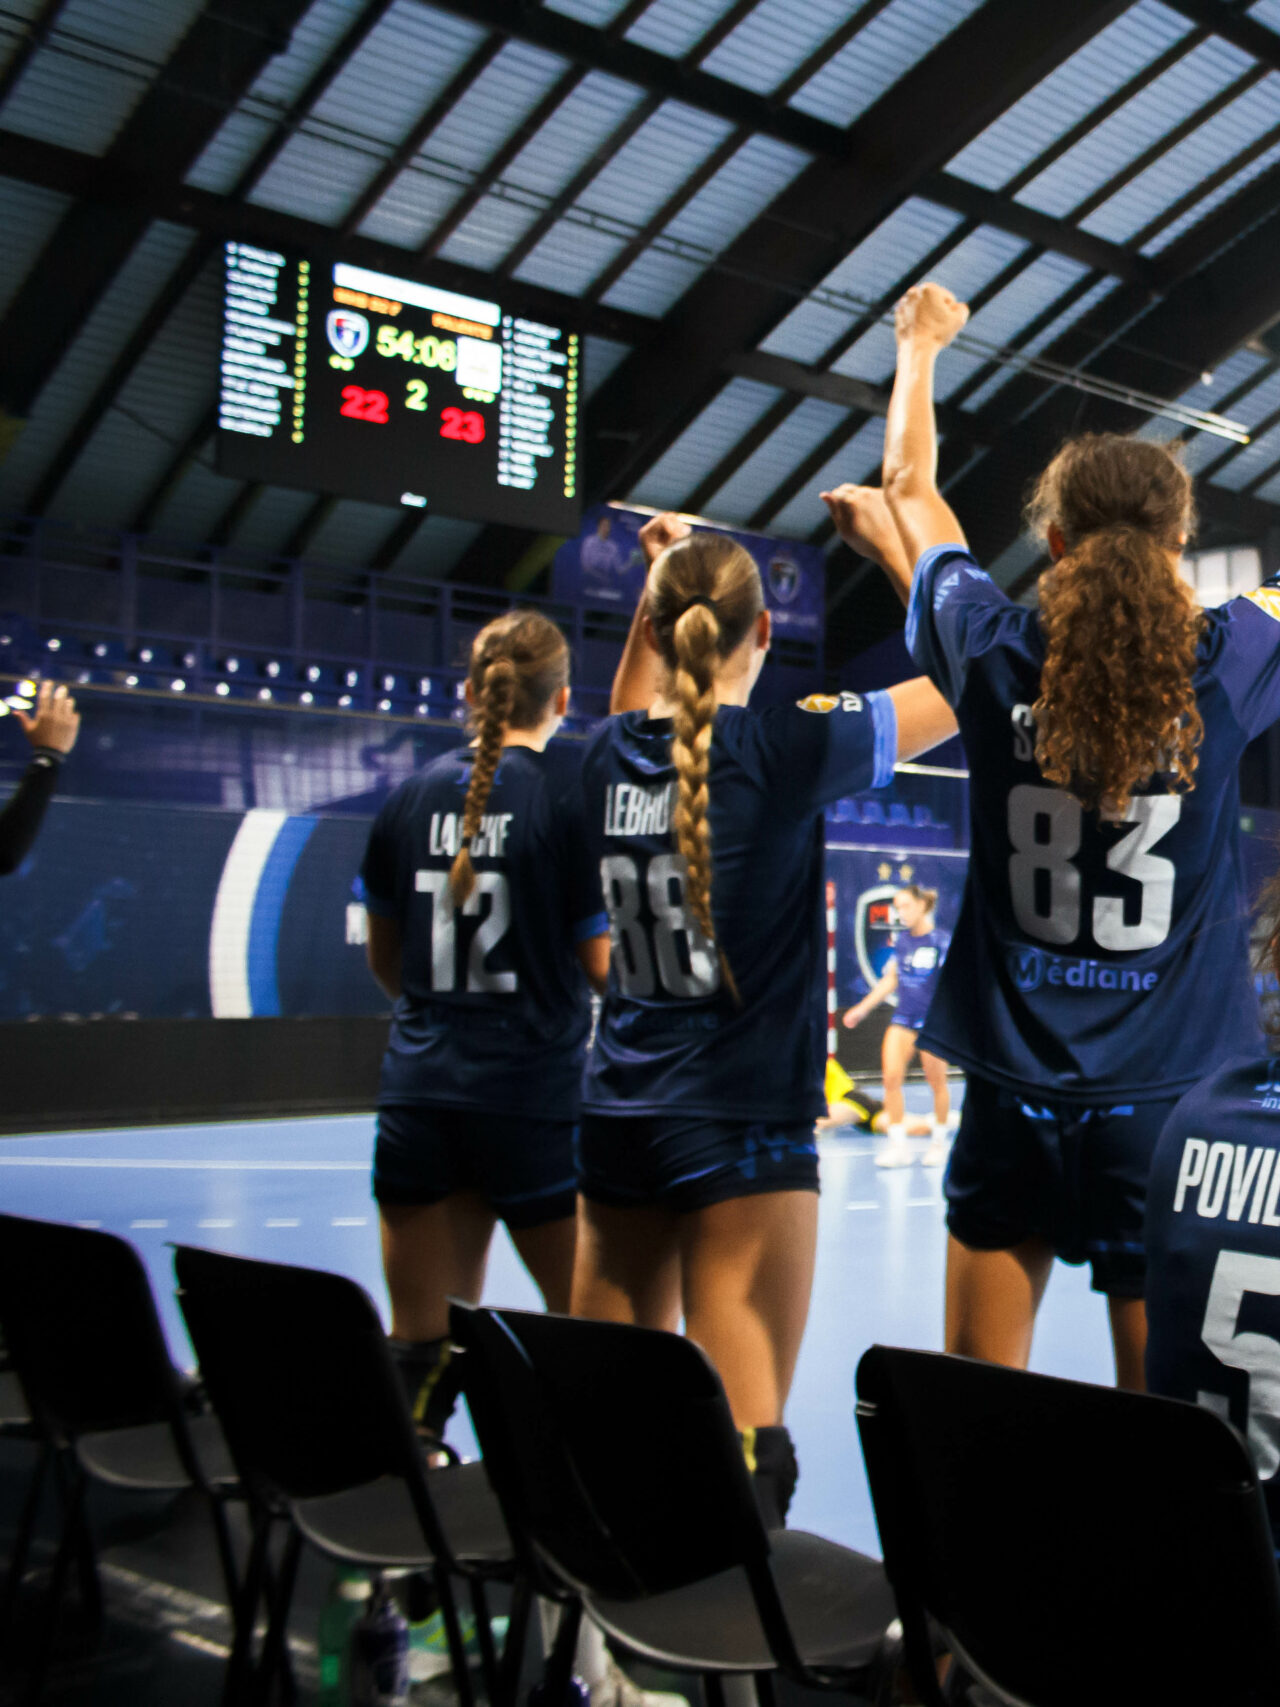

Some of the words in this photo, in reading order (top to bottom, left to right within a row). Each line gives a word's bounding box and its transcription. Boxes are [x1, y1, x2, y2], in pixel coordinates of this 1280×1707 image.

[340, 384, 389, 424] 22
[405, 378, 429, 411] 2
[440, 406, 486, 444] 23
[1007, 783, 1182, 952] 83
[414, 868, 518, 993] 12
[600, 854, 720, 998] 88
[1011, 946, 1160, 993] Médiane
